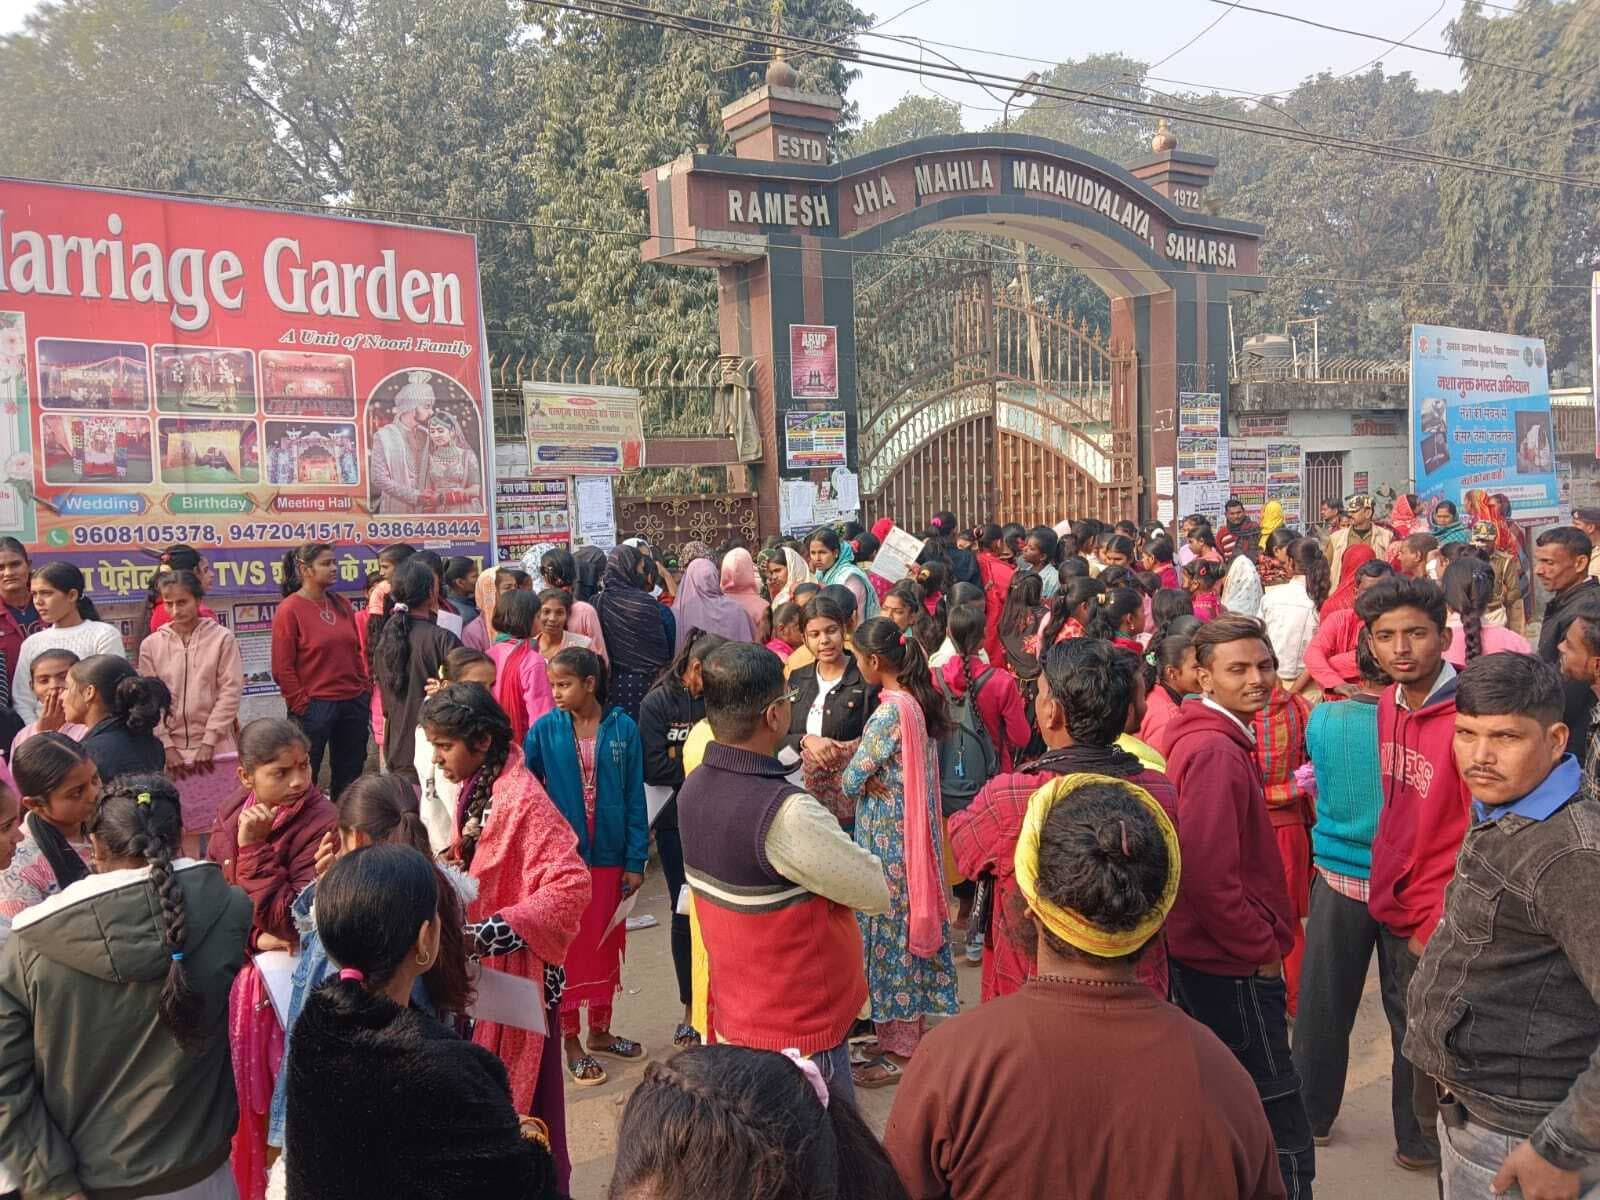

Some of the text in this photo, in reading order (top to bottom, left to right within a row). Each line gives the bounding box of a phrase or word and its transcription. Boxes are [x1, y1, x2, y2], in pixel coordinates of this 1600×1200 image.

[778, 134, 822, 161] ESTD
[1173, 188, 1200, 209] 1972
[728, 189, 831, 227] RAMESH
[852, 176, 897, 216] JHA
[913, 159, 994, 196] MAHILA
[1165, 232, 1237, 269] SAHARSA
[0, 208, 465, 332] arriage Garden
[279, 329, 472, 358] A Unit of Noori Family
[1437, 374, 1530, 398] नशा मुक्त भारत अभियान
[65, 497, 140, 512] Wedding
[181, 496, 247, 512] Birthday
[277, 496, 351, 511] Meeting Hall
[73, 520, 481, 545] 9608105378, 9472041517, 9386448444
[213, 561, 267, 586] TVS
[338, 553, 360, 583] के
